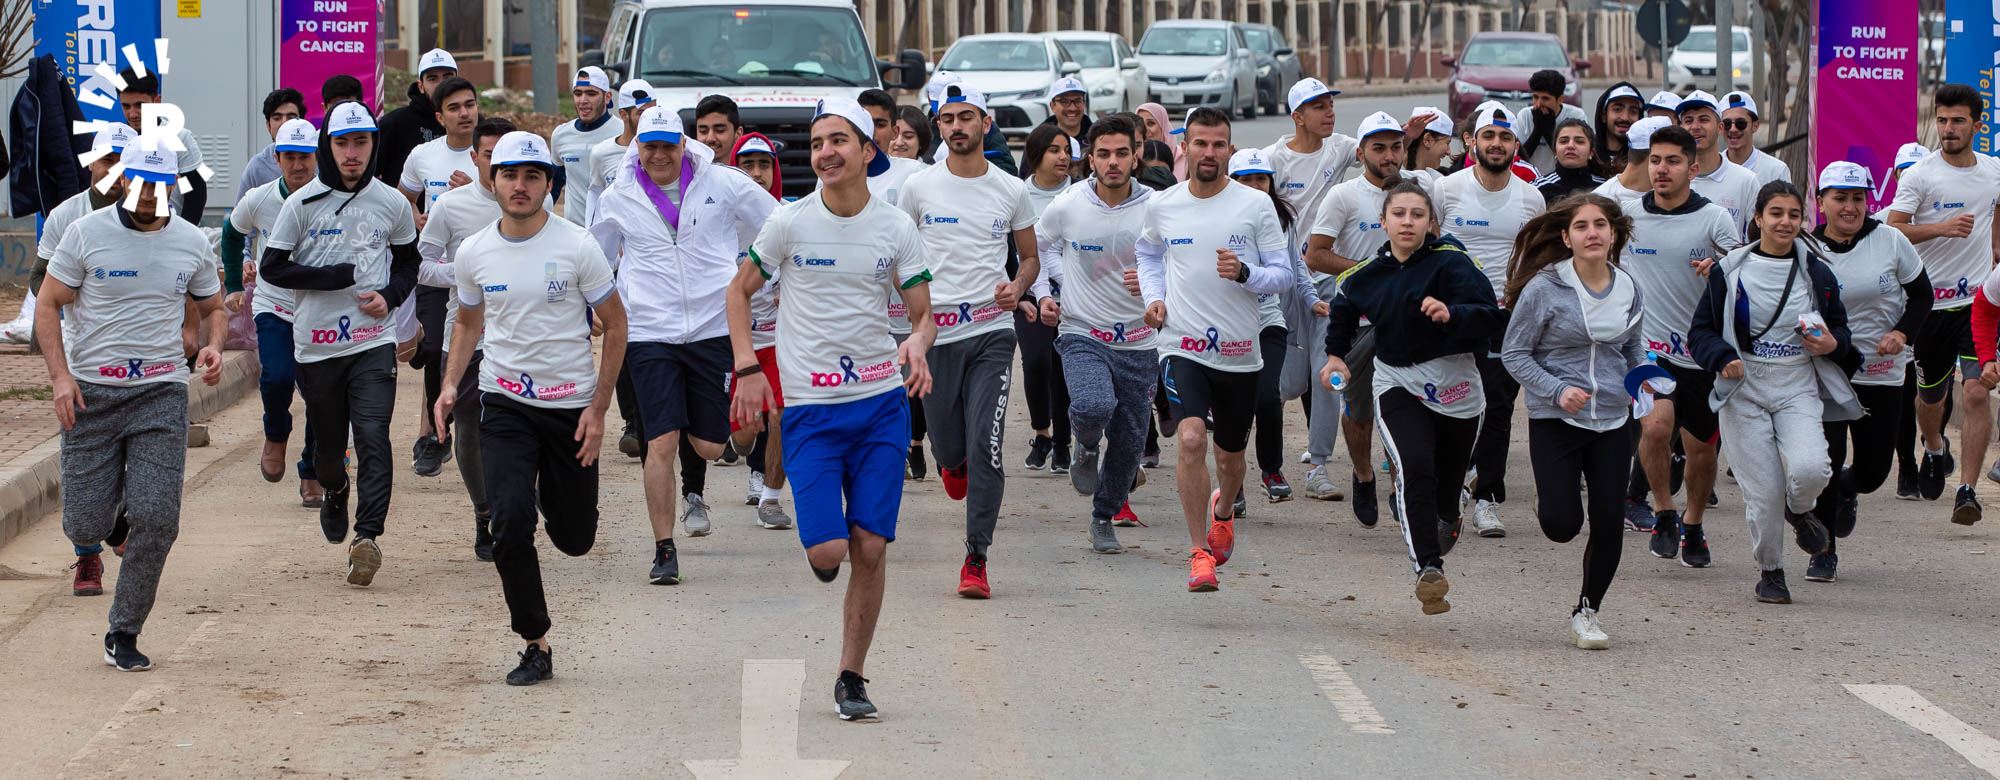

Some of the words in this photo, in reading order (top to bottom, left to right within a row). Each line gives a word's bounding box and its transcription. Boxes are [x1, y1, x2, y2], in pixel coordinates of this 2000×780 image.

[314, 1, 347, 13] RUN
[296, 20, 318, 32] TO
[322, 21, 368, 33] FIGHT
[1851, 26, 1886, 39] RUN
[300, 40, 364, 53] CANCER
[1833, 46, 1855, 59] TO
[1860, 47, 1908, 60] FIGHT
[1836, 66, 1904, 81] CANCER
[319, 206, 364, 224] PROERTY
[1228, 234, 1247, 244] AVI
[1080, 244, 1104, 252] KOREK
[1689, 248, 1706, 257] AVI
[805, 258, 837, 266] KOREK
[485, 284, 508, 292] KOREK
[547, 280, 568, 291] AVI
[933, 312, 958, 327] 100
[312, 329, 338, 344] 100
[1181, 336, 1207, 353] 100
[1220, 340, 1252, 348] CANCER
[858, 360, 893, 374] CANCER
[861, 367, 896, 380] SURVIVORS
[811, 371, 843, 387] 100
[538, 382, 577, 394] CANCER
[1438, 381, 1470, 398] CANCER
[989, 394, 1008, 469] adidas
